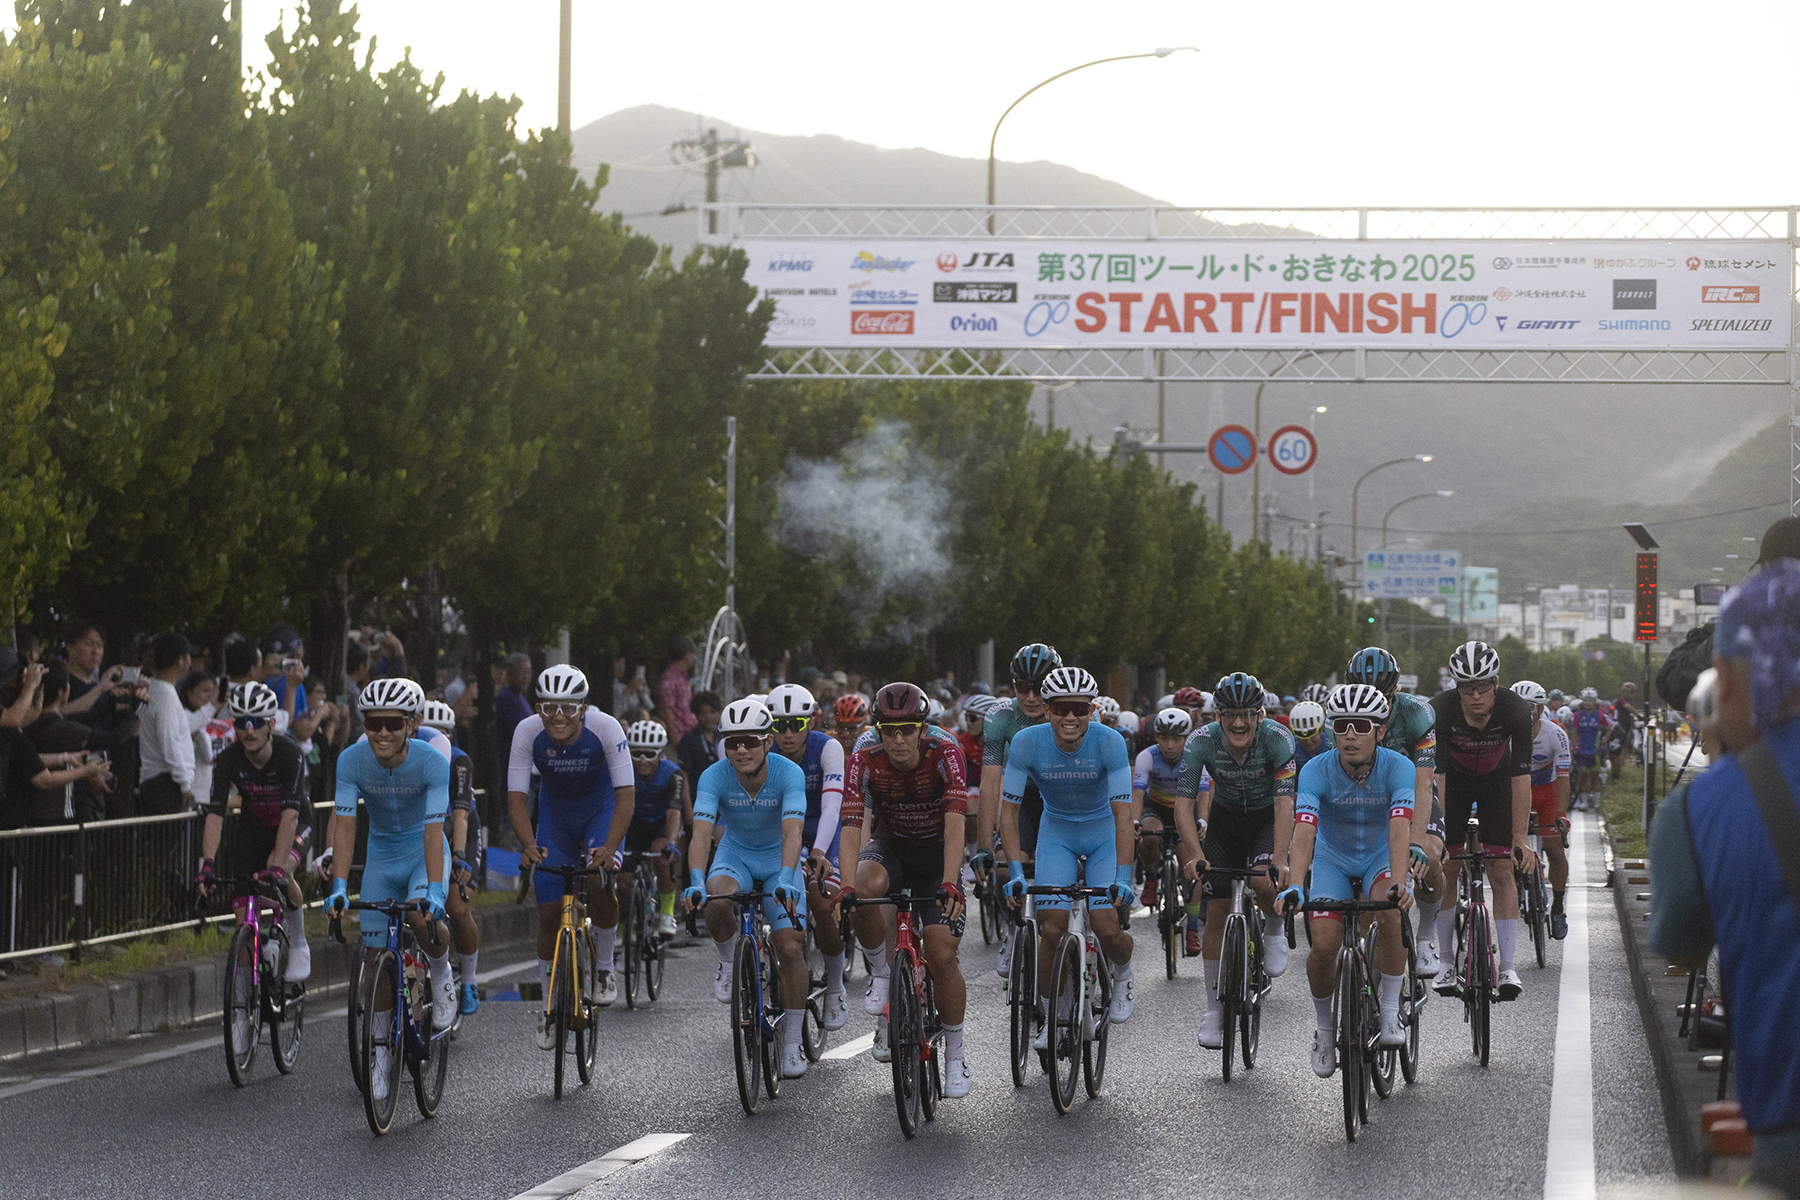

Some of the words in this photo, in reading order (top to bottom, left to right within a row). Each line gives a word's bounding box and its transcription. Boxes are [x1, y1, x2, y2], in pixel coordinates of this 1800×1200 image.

[963, 252, 1015, 267] JTA
[1703, 259, 1776, 269] 琉球セメント
[768, 260, 813, 272] KPMG
[1037, 252, 1475, 283] 第37回ツール・ド・おきなわ2025
[808, 288, 837, 296] HOTELS
[957, 288, 1012, 301] 沖縄マツダ
[1741, 293, 1758, 301] TIRE
[1074, 291, 1437, 334] START/FINISH
[951, 313, 998, 332] Orion
[1516, 320, 1581, 330] GIANT
[1598, 319, 1671, 331] SHIMANO
[1688, 319, 1773, 331] SPECIALIZED
[1279, 439, 1307, 462] 60
[547, 758, 590, 766] CHINESE
[824, 773, 843, 782] TPE
[1040, 771, 1098, 780] SHIMANO
[364, 785, 420, 795] SHIMANO
[881, 798, 942, 810] Astemo
[1332, 797, 1387, 805] SHIMANO
[425, 812, 446, 820] GIAN
